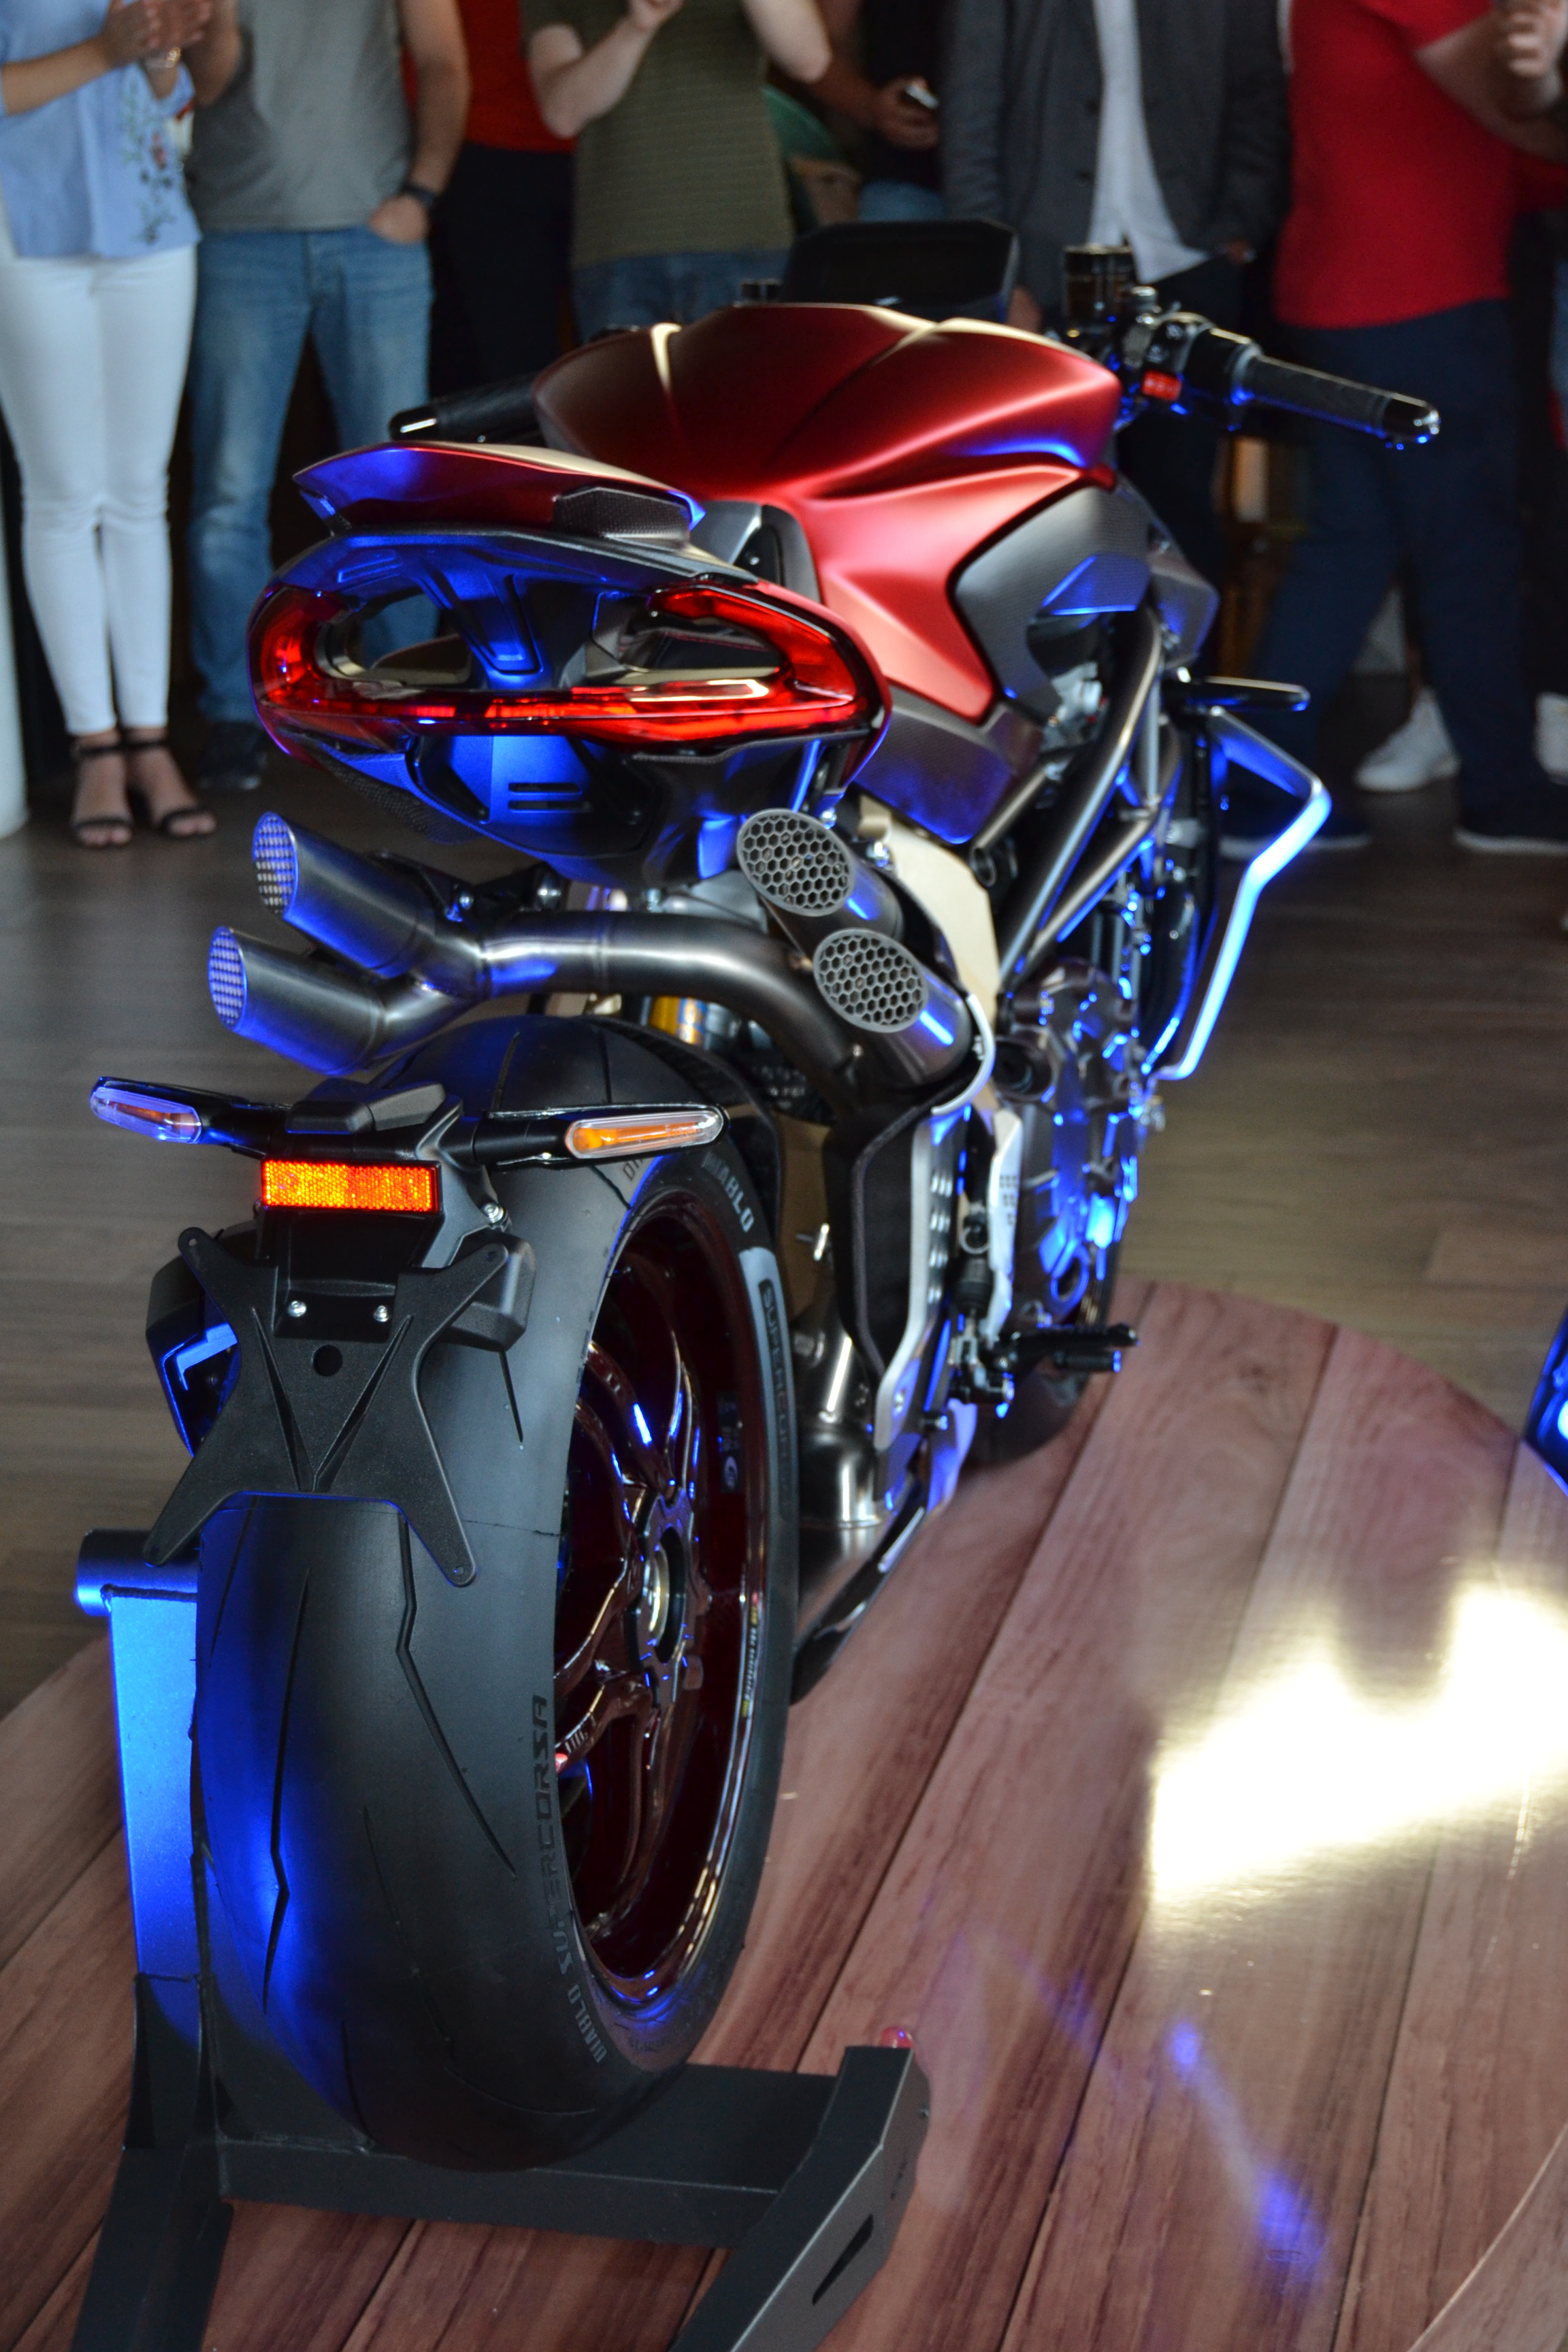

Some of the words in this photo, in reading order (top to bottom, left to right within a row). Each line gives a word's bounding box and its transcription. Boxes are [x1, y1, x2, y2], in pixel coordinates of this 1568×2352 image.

[762, 1285, 789, 1506] SUPERCOR
[532, 1694, 574, 1975] SUPERCORSA
[568, 1984, 608, 2063] DIABLO
